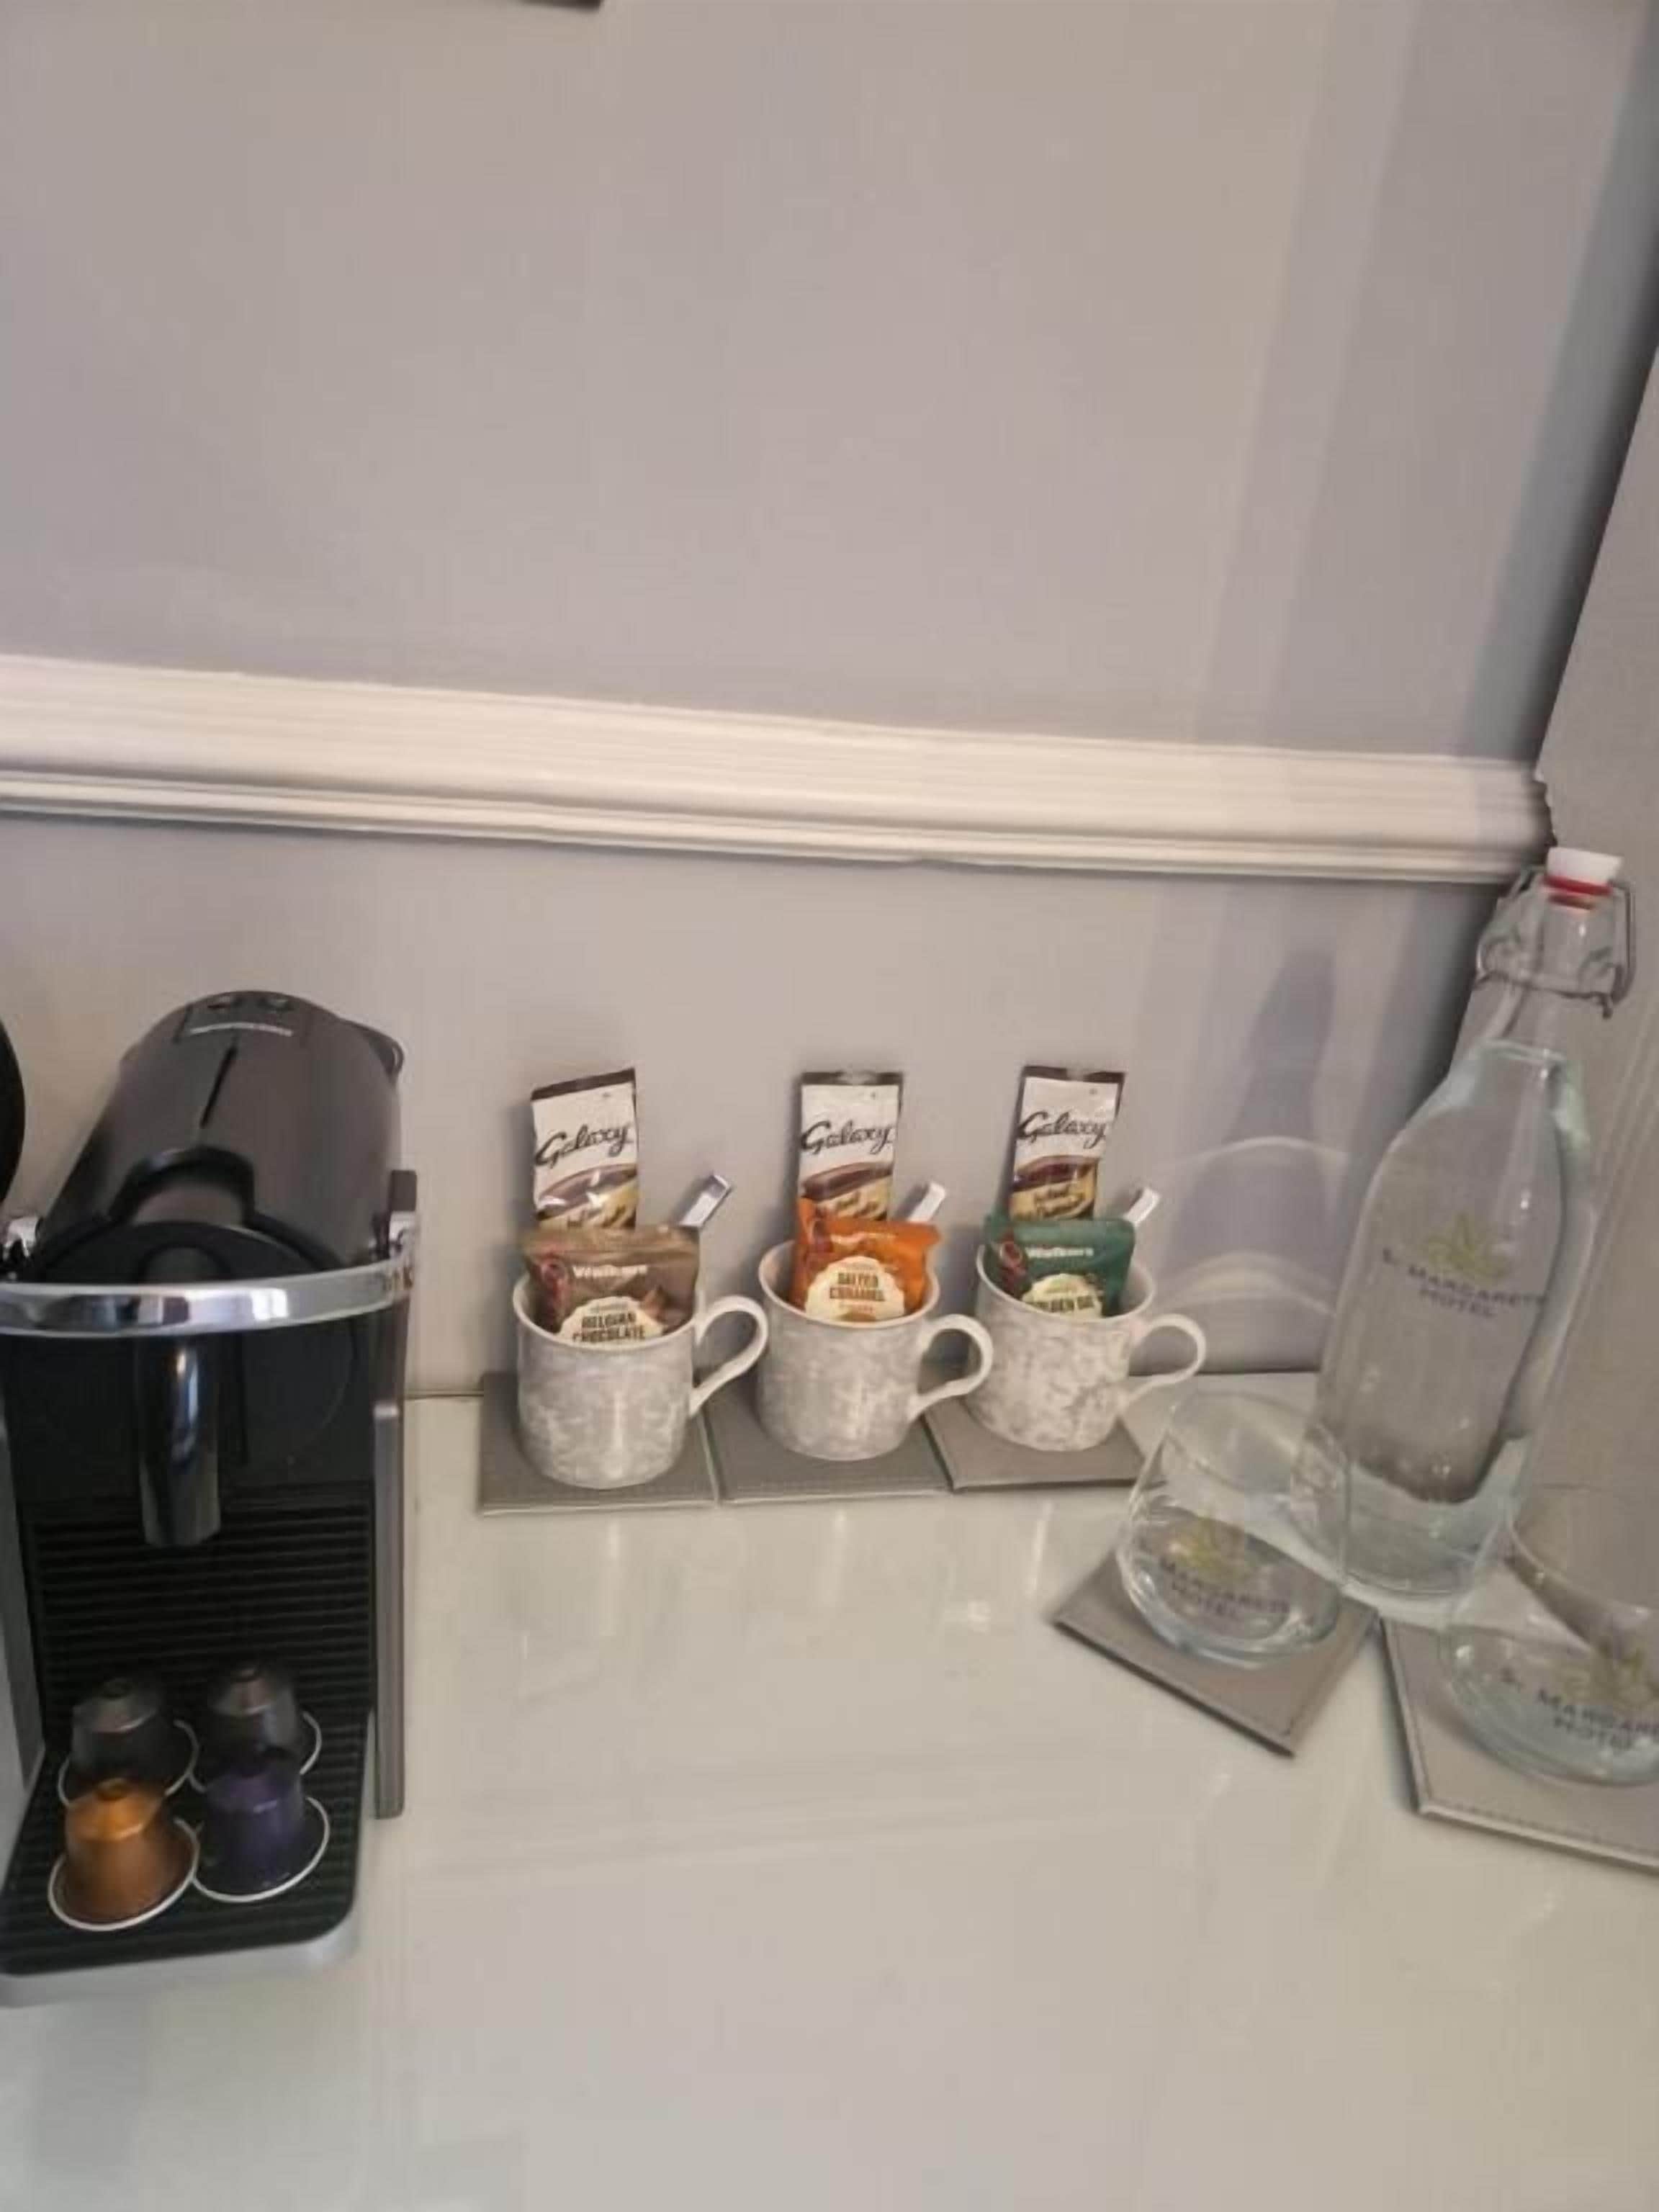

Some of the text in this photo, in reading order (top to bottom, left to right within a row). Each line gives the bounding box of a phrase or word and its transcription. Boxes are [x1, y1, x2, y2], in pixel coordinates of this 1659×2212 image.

[535, 1123, 634, 1169] Galaxy
[800, 1120, 894, 1155] Galaxy
[1016, 1111, 1107, 1149] Galaxy
